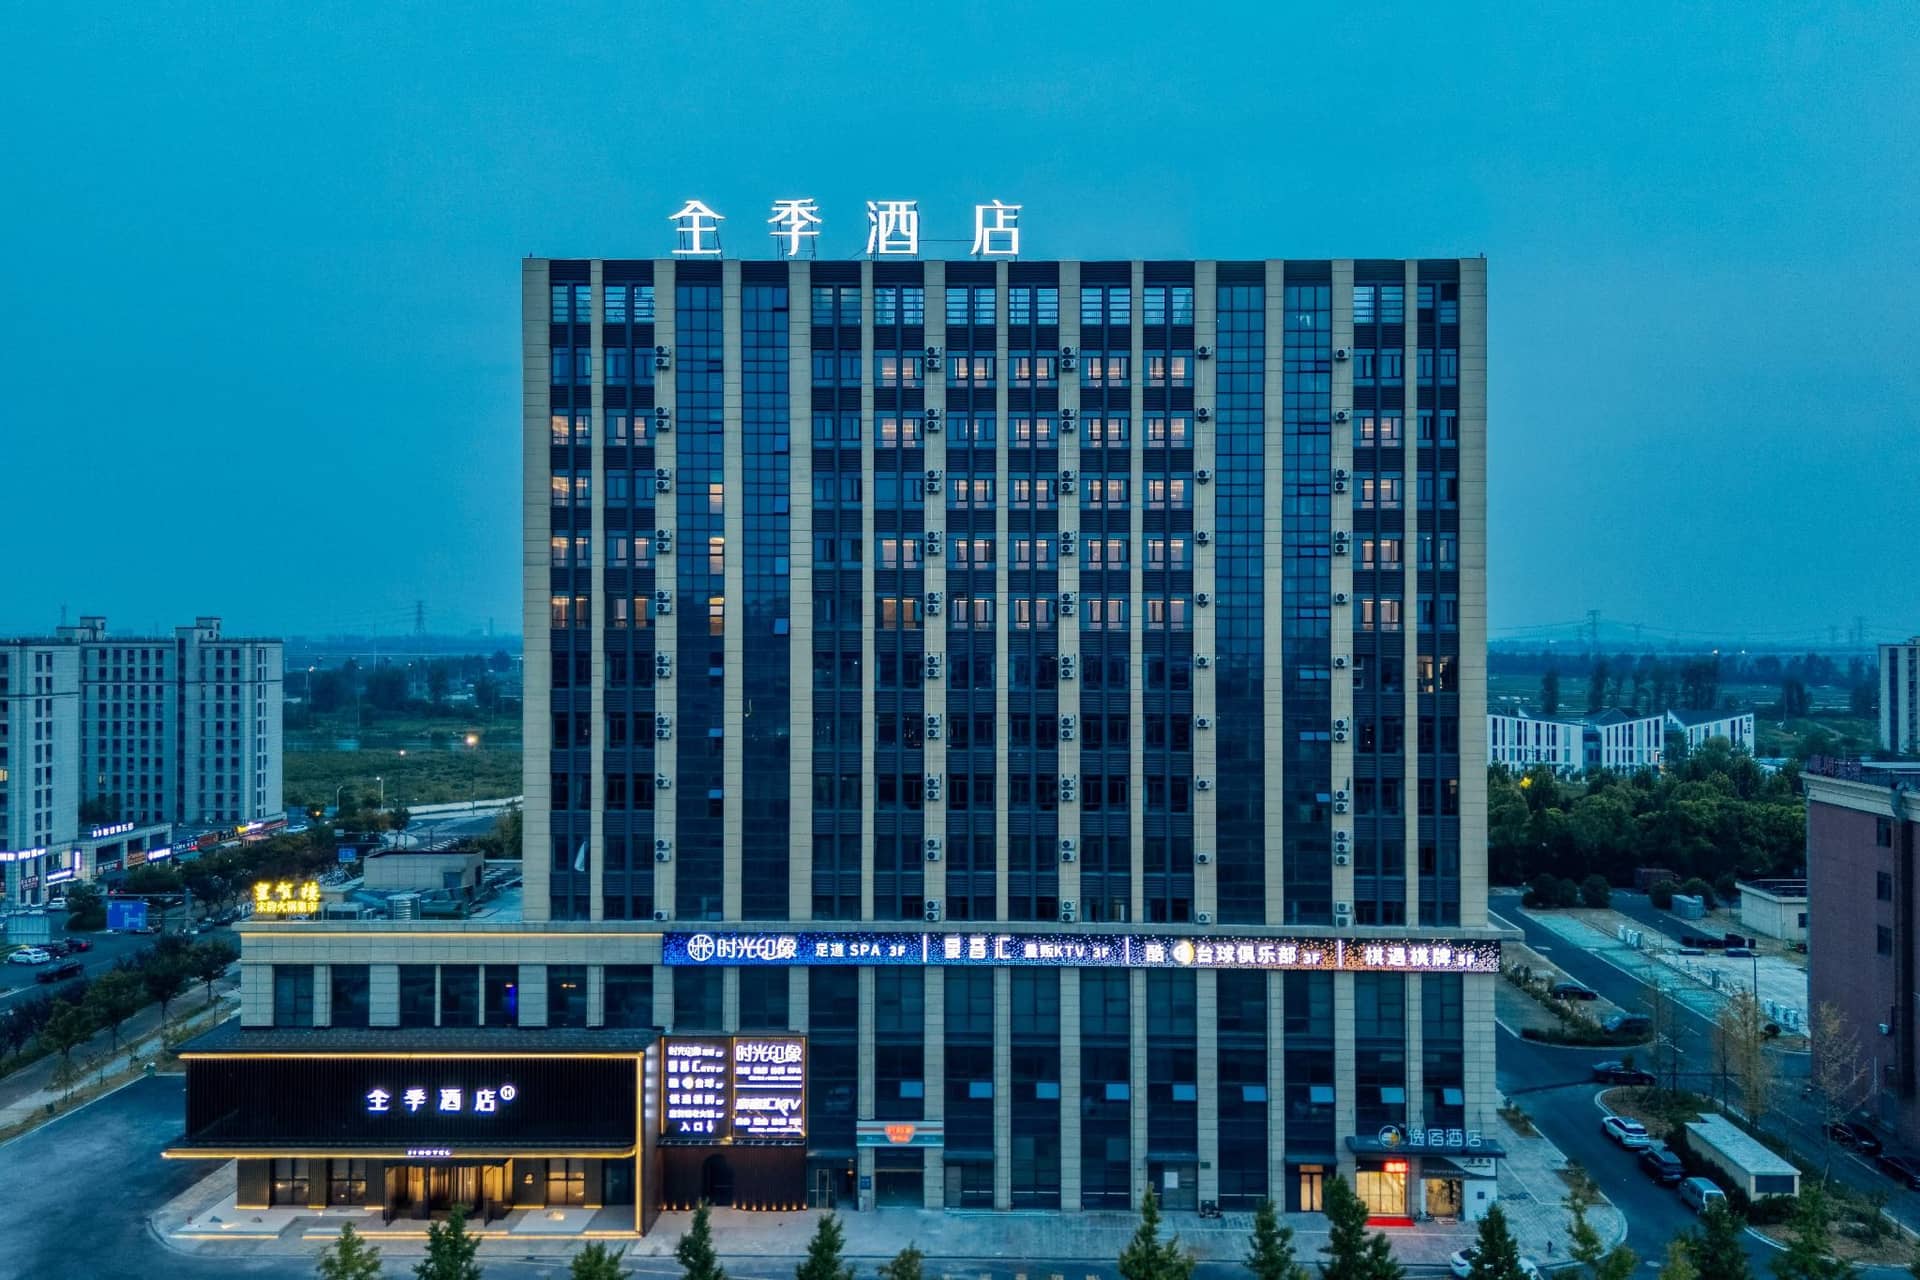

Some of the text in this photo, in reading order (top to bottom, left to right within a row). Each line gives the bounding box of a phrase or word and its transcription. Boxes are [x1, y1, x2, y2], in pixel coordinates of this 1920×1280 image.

[669, 199, 1023, 256] 全季酒店
[815, 942, 844, 958] 足道
[849, 944, 881, 957] SPA
[889, 945, 906, 957] 3F
[1092, 947, 1109, 958] 3F
[1198, 945, 1297, 965] 台球俱乐部
[1303, 953, 1320, 964] 3F
[1458, 954, 1475, 967] 5F
[367, 1088, 498, 1112] 全季酒店
